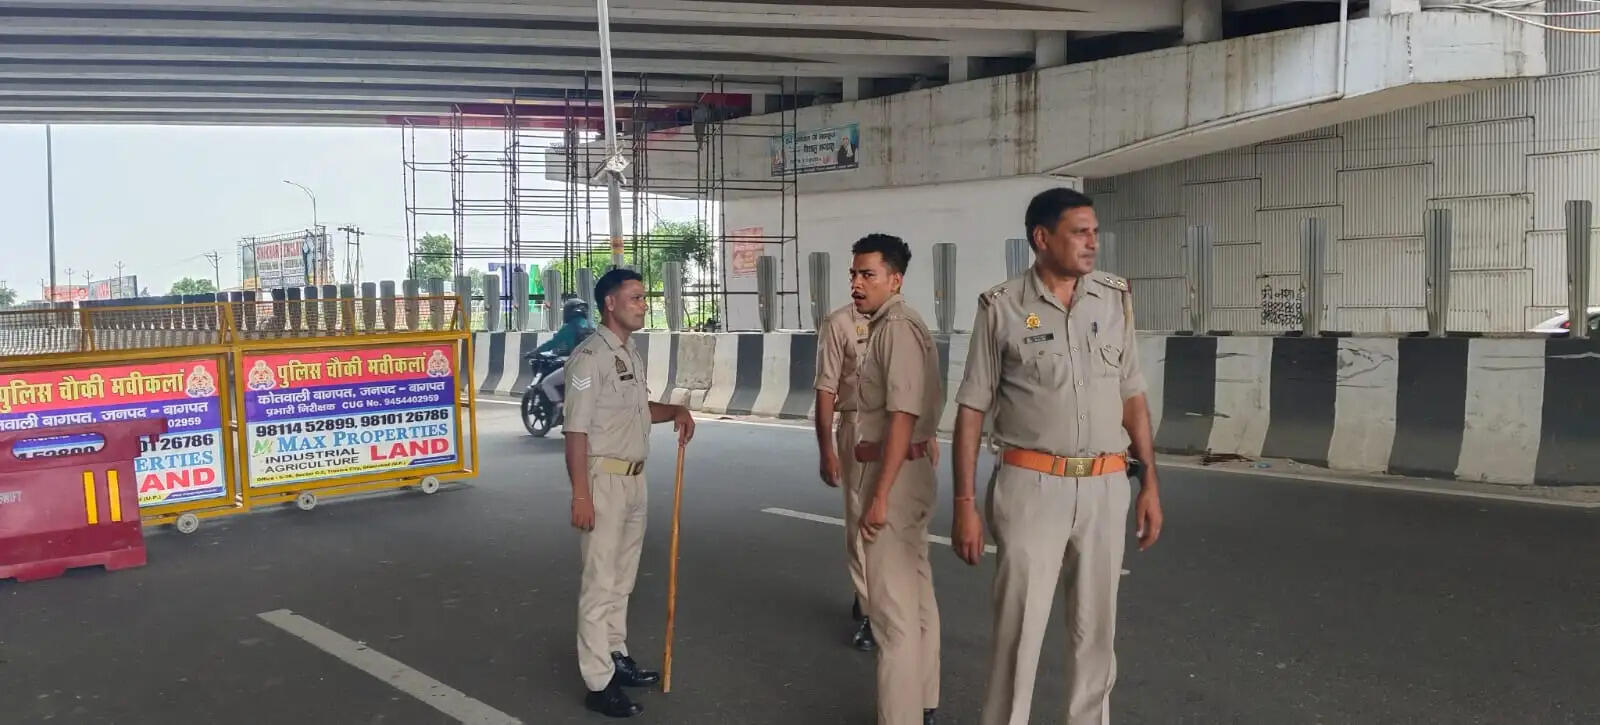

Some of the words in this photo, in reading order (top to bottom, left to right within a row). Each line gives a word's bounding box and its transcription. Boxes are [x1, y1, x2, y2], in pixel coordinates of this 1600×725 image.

[277, 359, 322, 389] पुलिस
[326, 355, 362, 378] चौकी
[366, 352, 427, 376] मवीकलां
[0, 379, 53, 412] पुलिस
[58, 373, 105, 401] चौकी
[257, 388, 311, 405] कोतवाली
[312, 388, 356, 400] बागपत,
[359, 385, 396, 396] जनपद
[408, 382, 445, 393] बागपत
[162, 402, 208, 416] बागपत
[266, 405, 295, 418] प्रभारी
[297, 402, 337, 413] निरीक्षक
[341, 399, 364, 409] CUG
[366, 398, 382, 407] No.
[384, 394, 440, 406] 9454402959
[167, 416, 202, 428] 02959
[256, 422, 303, 437] 98114
[305, 417, 358, 432] 52899,
[360, 413, 402, 427] 98101
[405, 409, 449, 422] 26786
[277, 434, 327, 453] MAX
[332, 424, 448, 447] PROPERTIES
[135, 450, 214, 472] ERTIES
[264, 456, 359, 474] AGRICULTURE
[370, 438, 449, 461] LAND
[266, 448, 360, 464] INDUSTRIAL
[139, 467, 216, 493] AND
